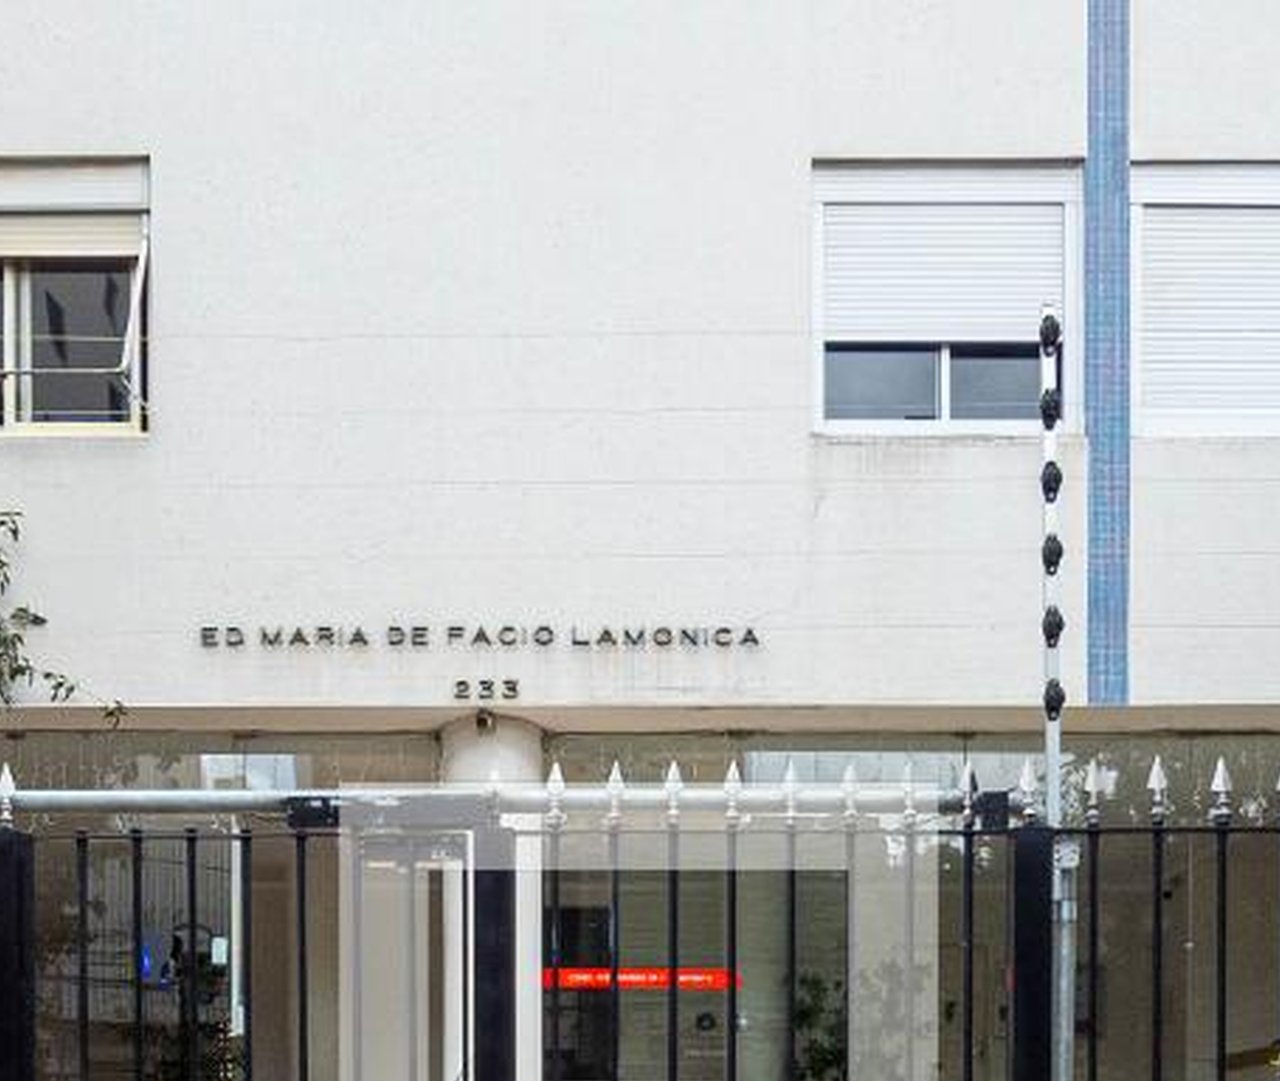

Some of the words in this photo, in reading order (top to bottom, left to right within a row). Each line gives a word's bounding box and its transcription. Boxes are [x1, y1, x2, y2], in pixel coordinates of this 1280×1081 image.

[201, 626, 244, 647] ED
[260, 626, 369, 647] MARIA
[387, 626, 429, 646] DE
[447, 626, 555, 646] FACIO
[572, 626, 760, 646] LAMONICA
[454, 679, 520, 699] 233
